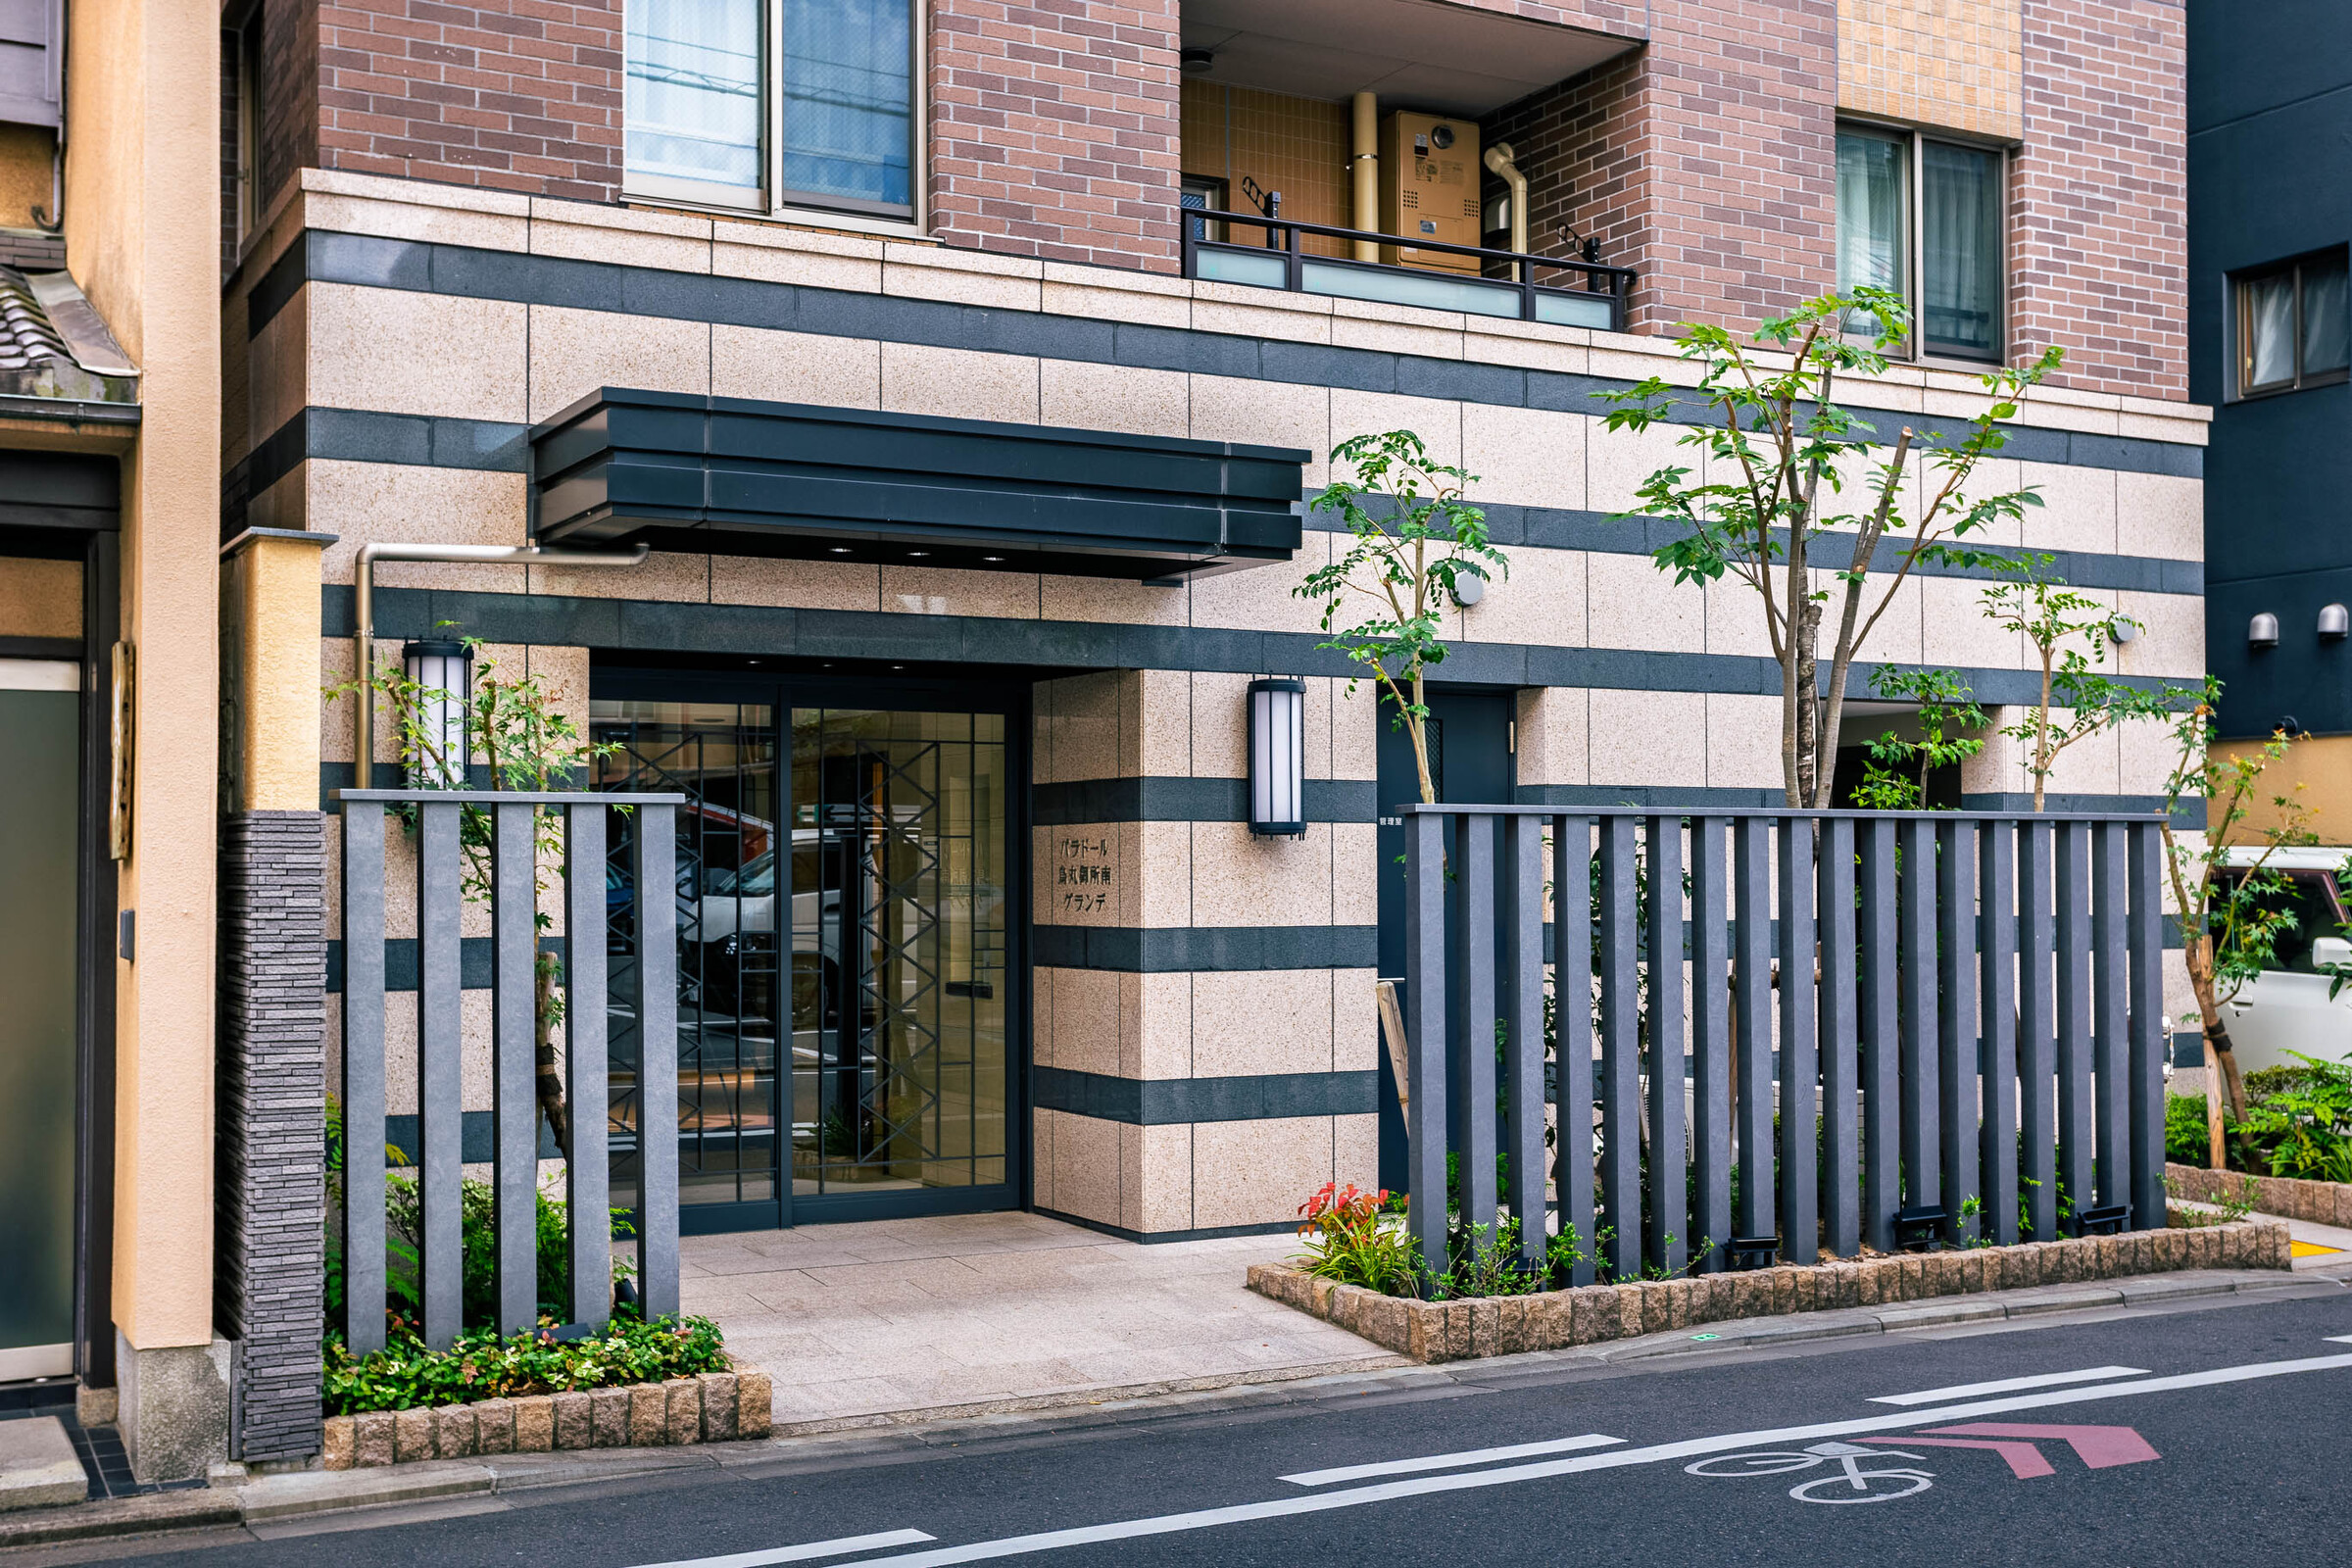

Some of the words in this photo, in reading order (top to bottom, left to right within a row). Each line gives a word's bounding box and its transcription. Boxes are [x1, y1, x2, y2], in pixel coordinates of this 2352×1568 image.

[1060, 838, 1108, 858] パラドール
[1064, 893, 1105, 912] グランデ
